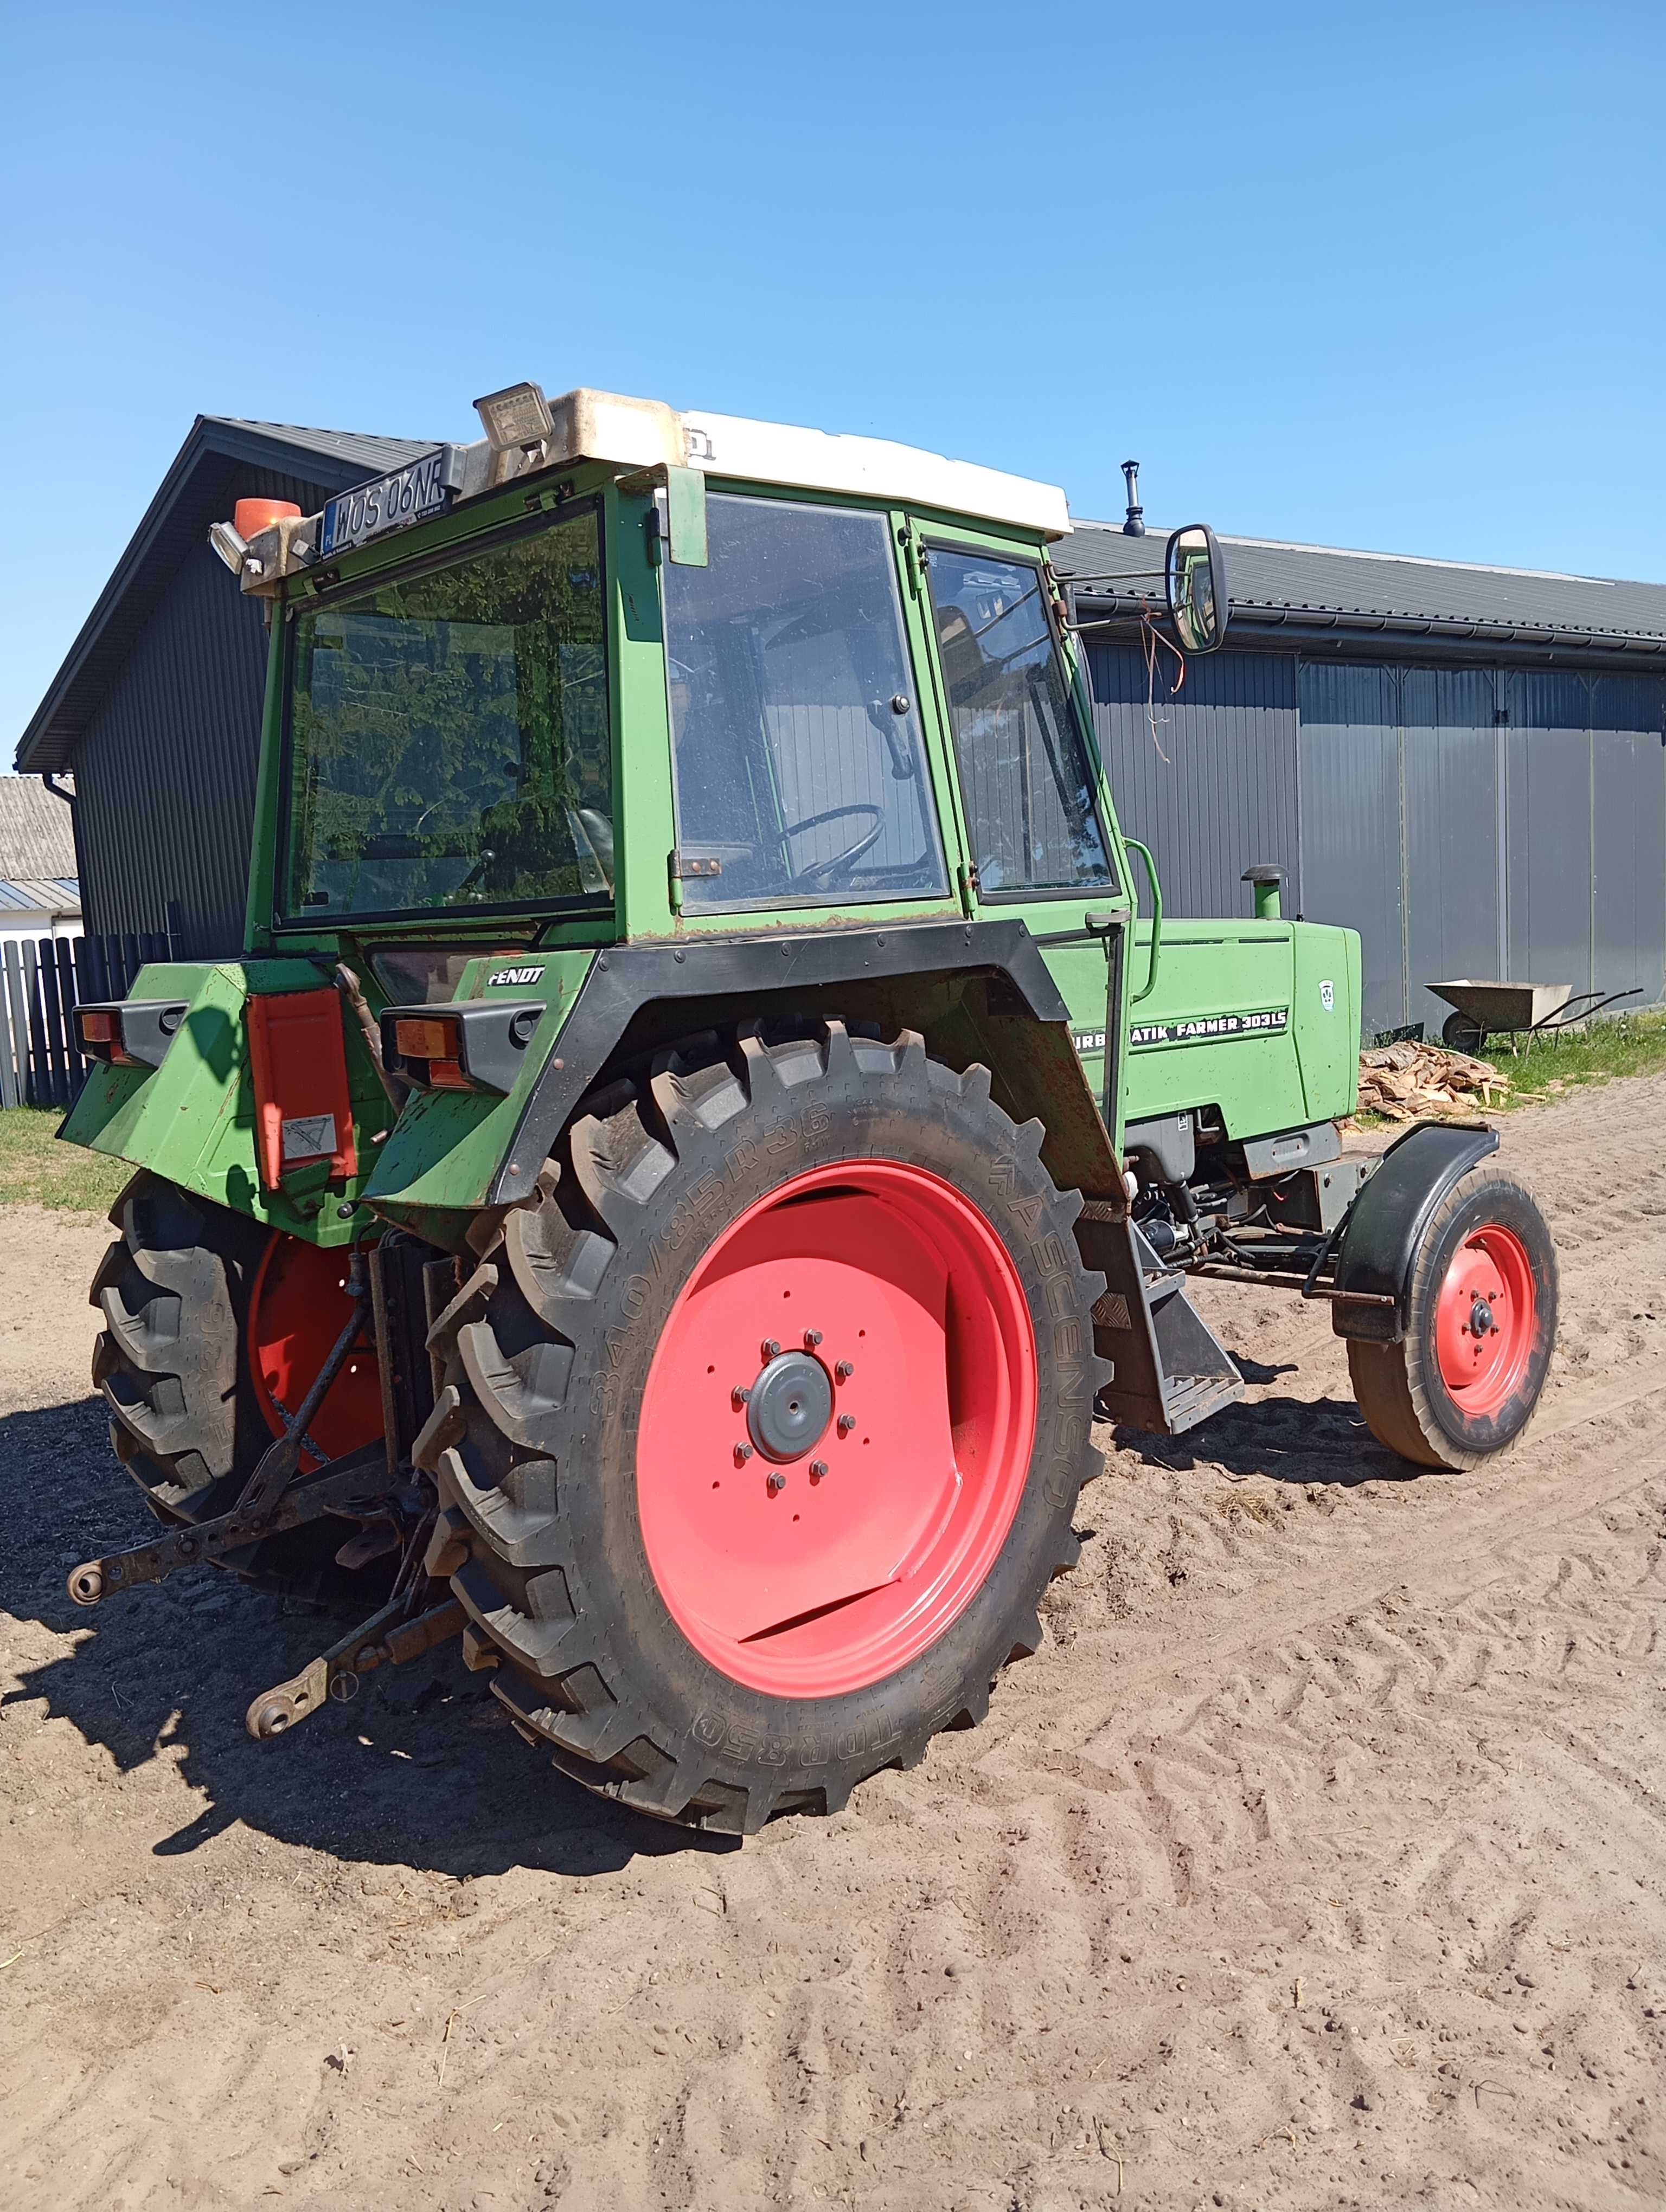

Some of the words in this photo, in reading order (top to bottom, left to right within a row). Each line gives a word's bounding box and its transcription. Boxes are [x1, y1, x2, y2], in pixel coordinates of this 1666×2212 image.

[336, 486, 381, 543] WOS
[325, 535, 332, 547] PL
[488, 967, 546, 985] FENDT
[1176, 1017, 1238, 1037] FARMER
[1241, 1011, 1286, 1030] 303LS
[1007, 1193, 1085, 1509] ASCENSO
